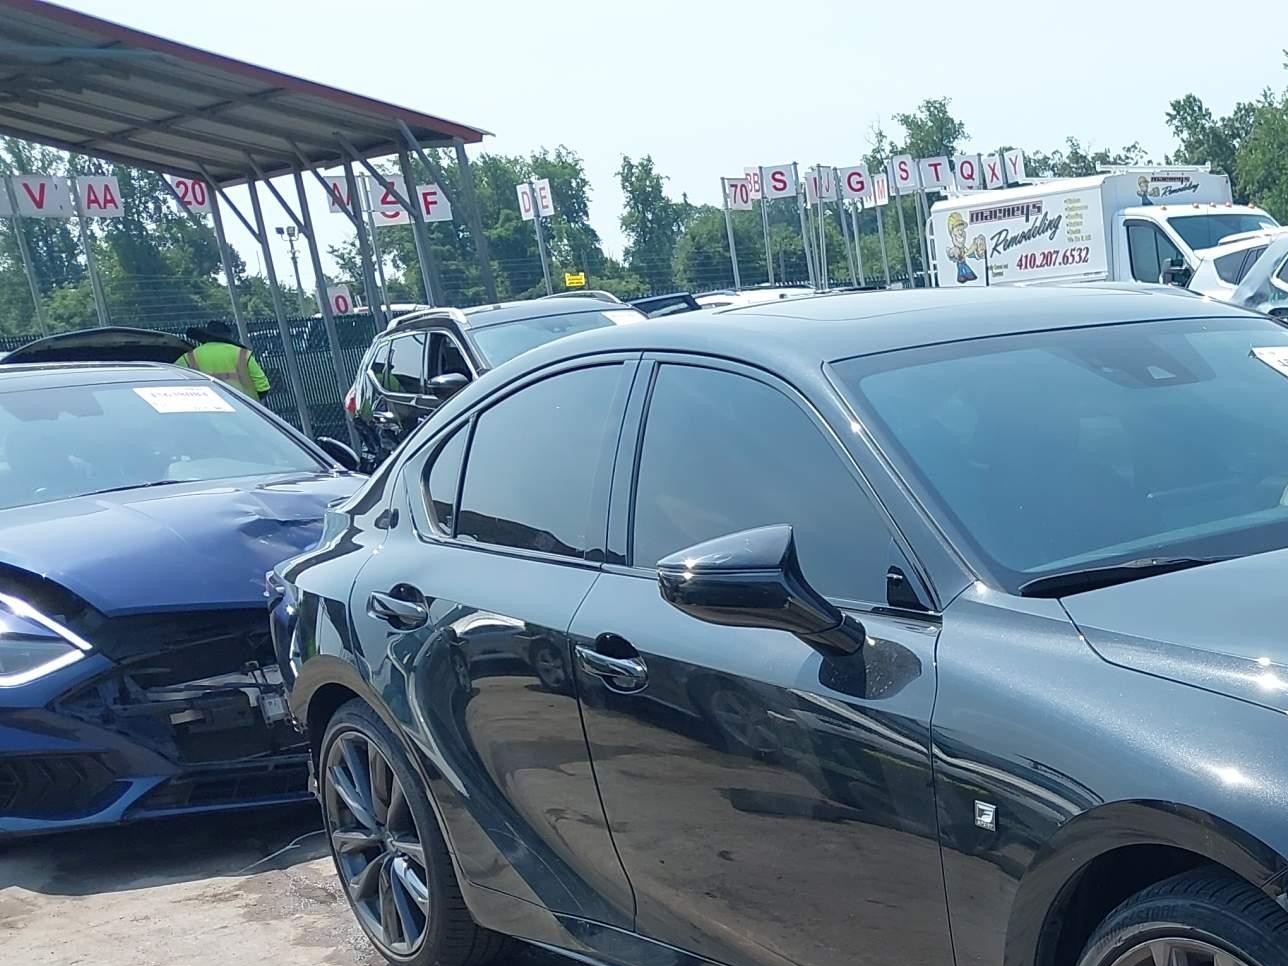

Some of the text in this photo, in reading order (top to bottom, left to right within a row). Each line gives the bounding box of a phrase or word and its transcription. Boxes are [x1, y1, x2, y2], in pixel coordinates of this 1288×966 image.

[899, 161, 909, 181] S
[928, 163, 942, 182] T
[960, 160, 975, 181] Q
[987, 162, 1000, 183] X
[1009, 155, 1018, 175] Y
[175, 177, 206, 206] 20
[771, 171, 787, 191] S
[847, 172, 865, 192] G
[22, 182, 46, 209] V
[87, 183, 119, 210] AA
[421, 191, 438, 215] F
[521, 191, 531, 213] D
[539, 186, 549, 209] E
[729, 184, 749, 204] 70
[990, 212, 1062, 258] Remodeling
[1016, 247, 1089, 270] 410.207.6532
